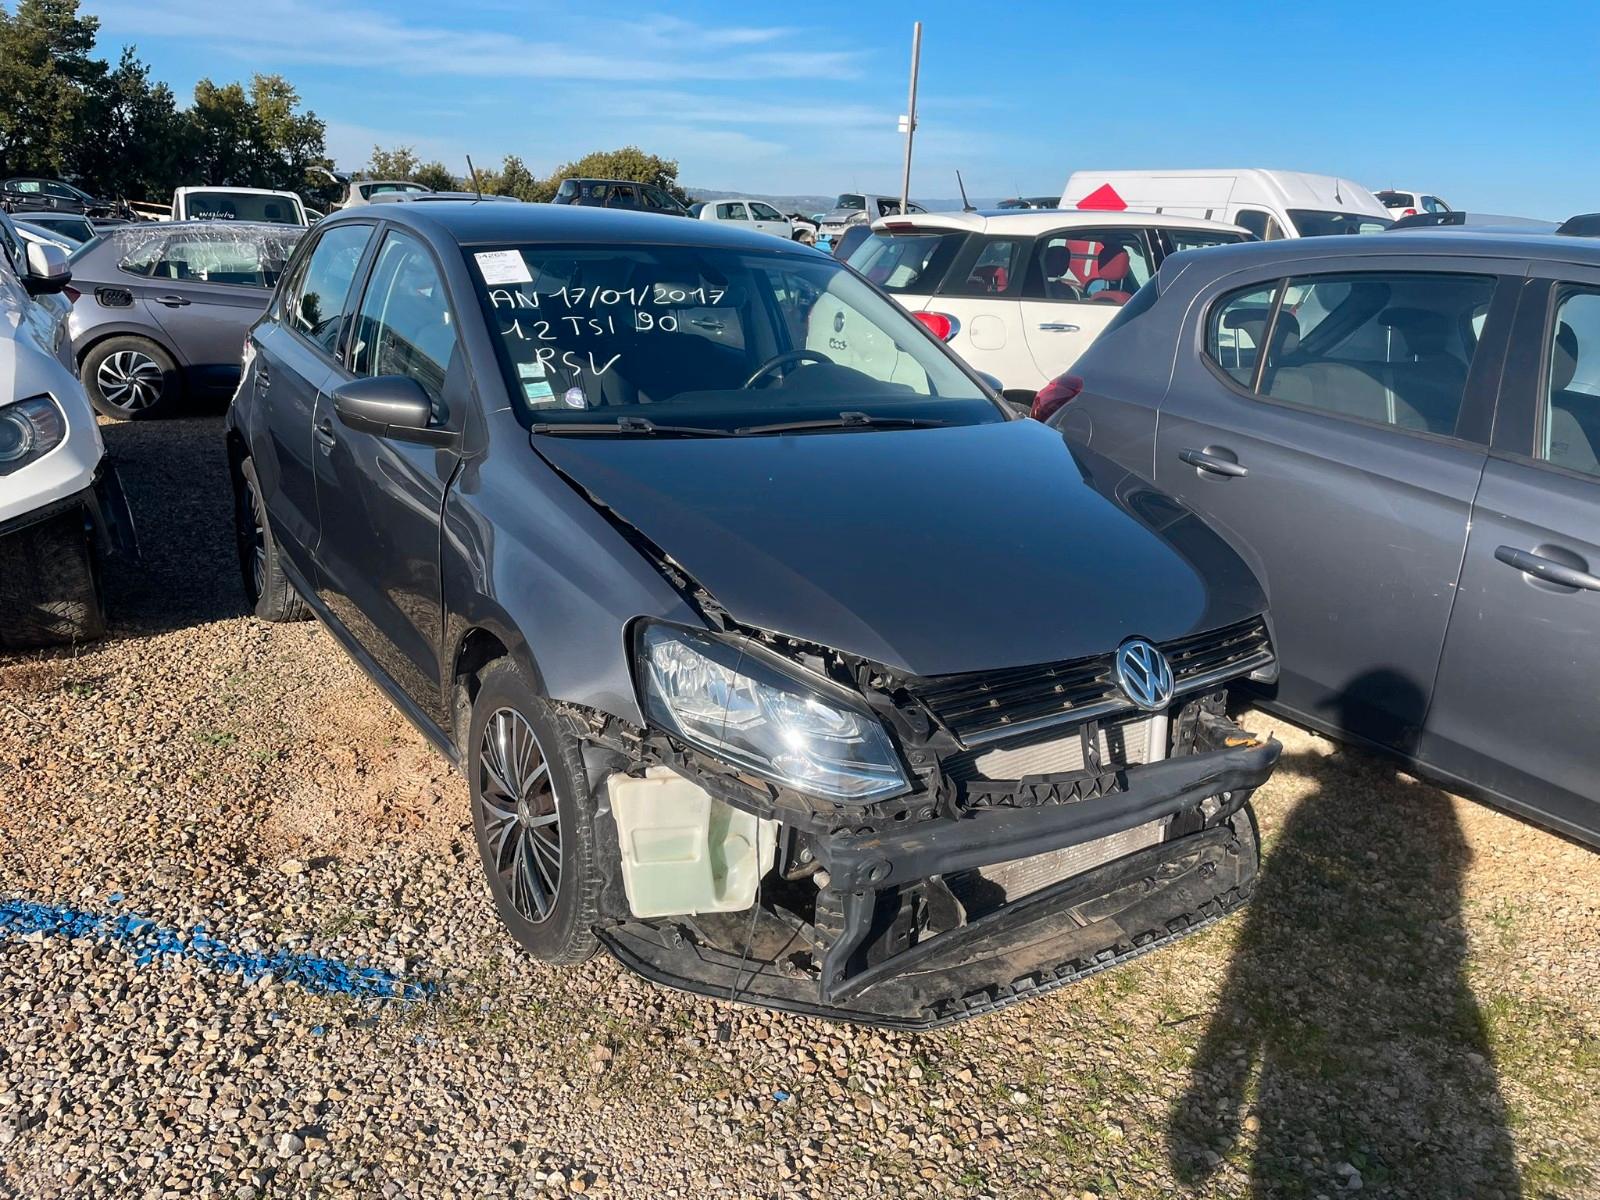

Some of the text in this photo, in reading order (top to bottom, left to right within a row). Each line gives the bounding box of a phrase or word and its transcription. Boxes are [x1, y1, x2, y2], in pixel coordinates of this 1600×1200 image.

[488, 285, 726, 310] AN 17/01/2017
[500, 311, 679, 341] 1.2 TSI 90
[534, 346, 622, 377] RSV
